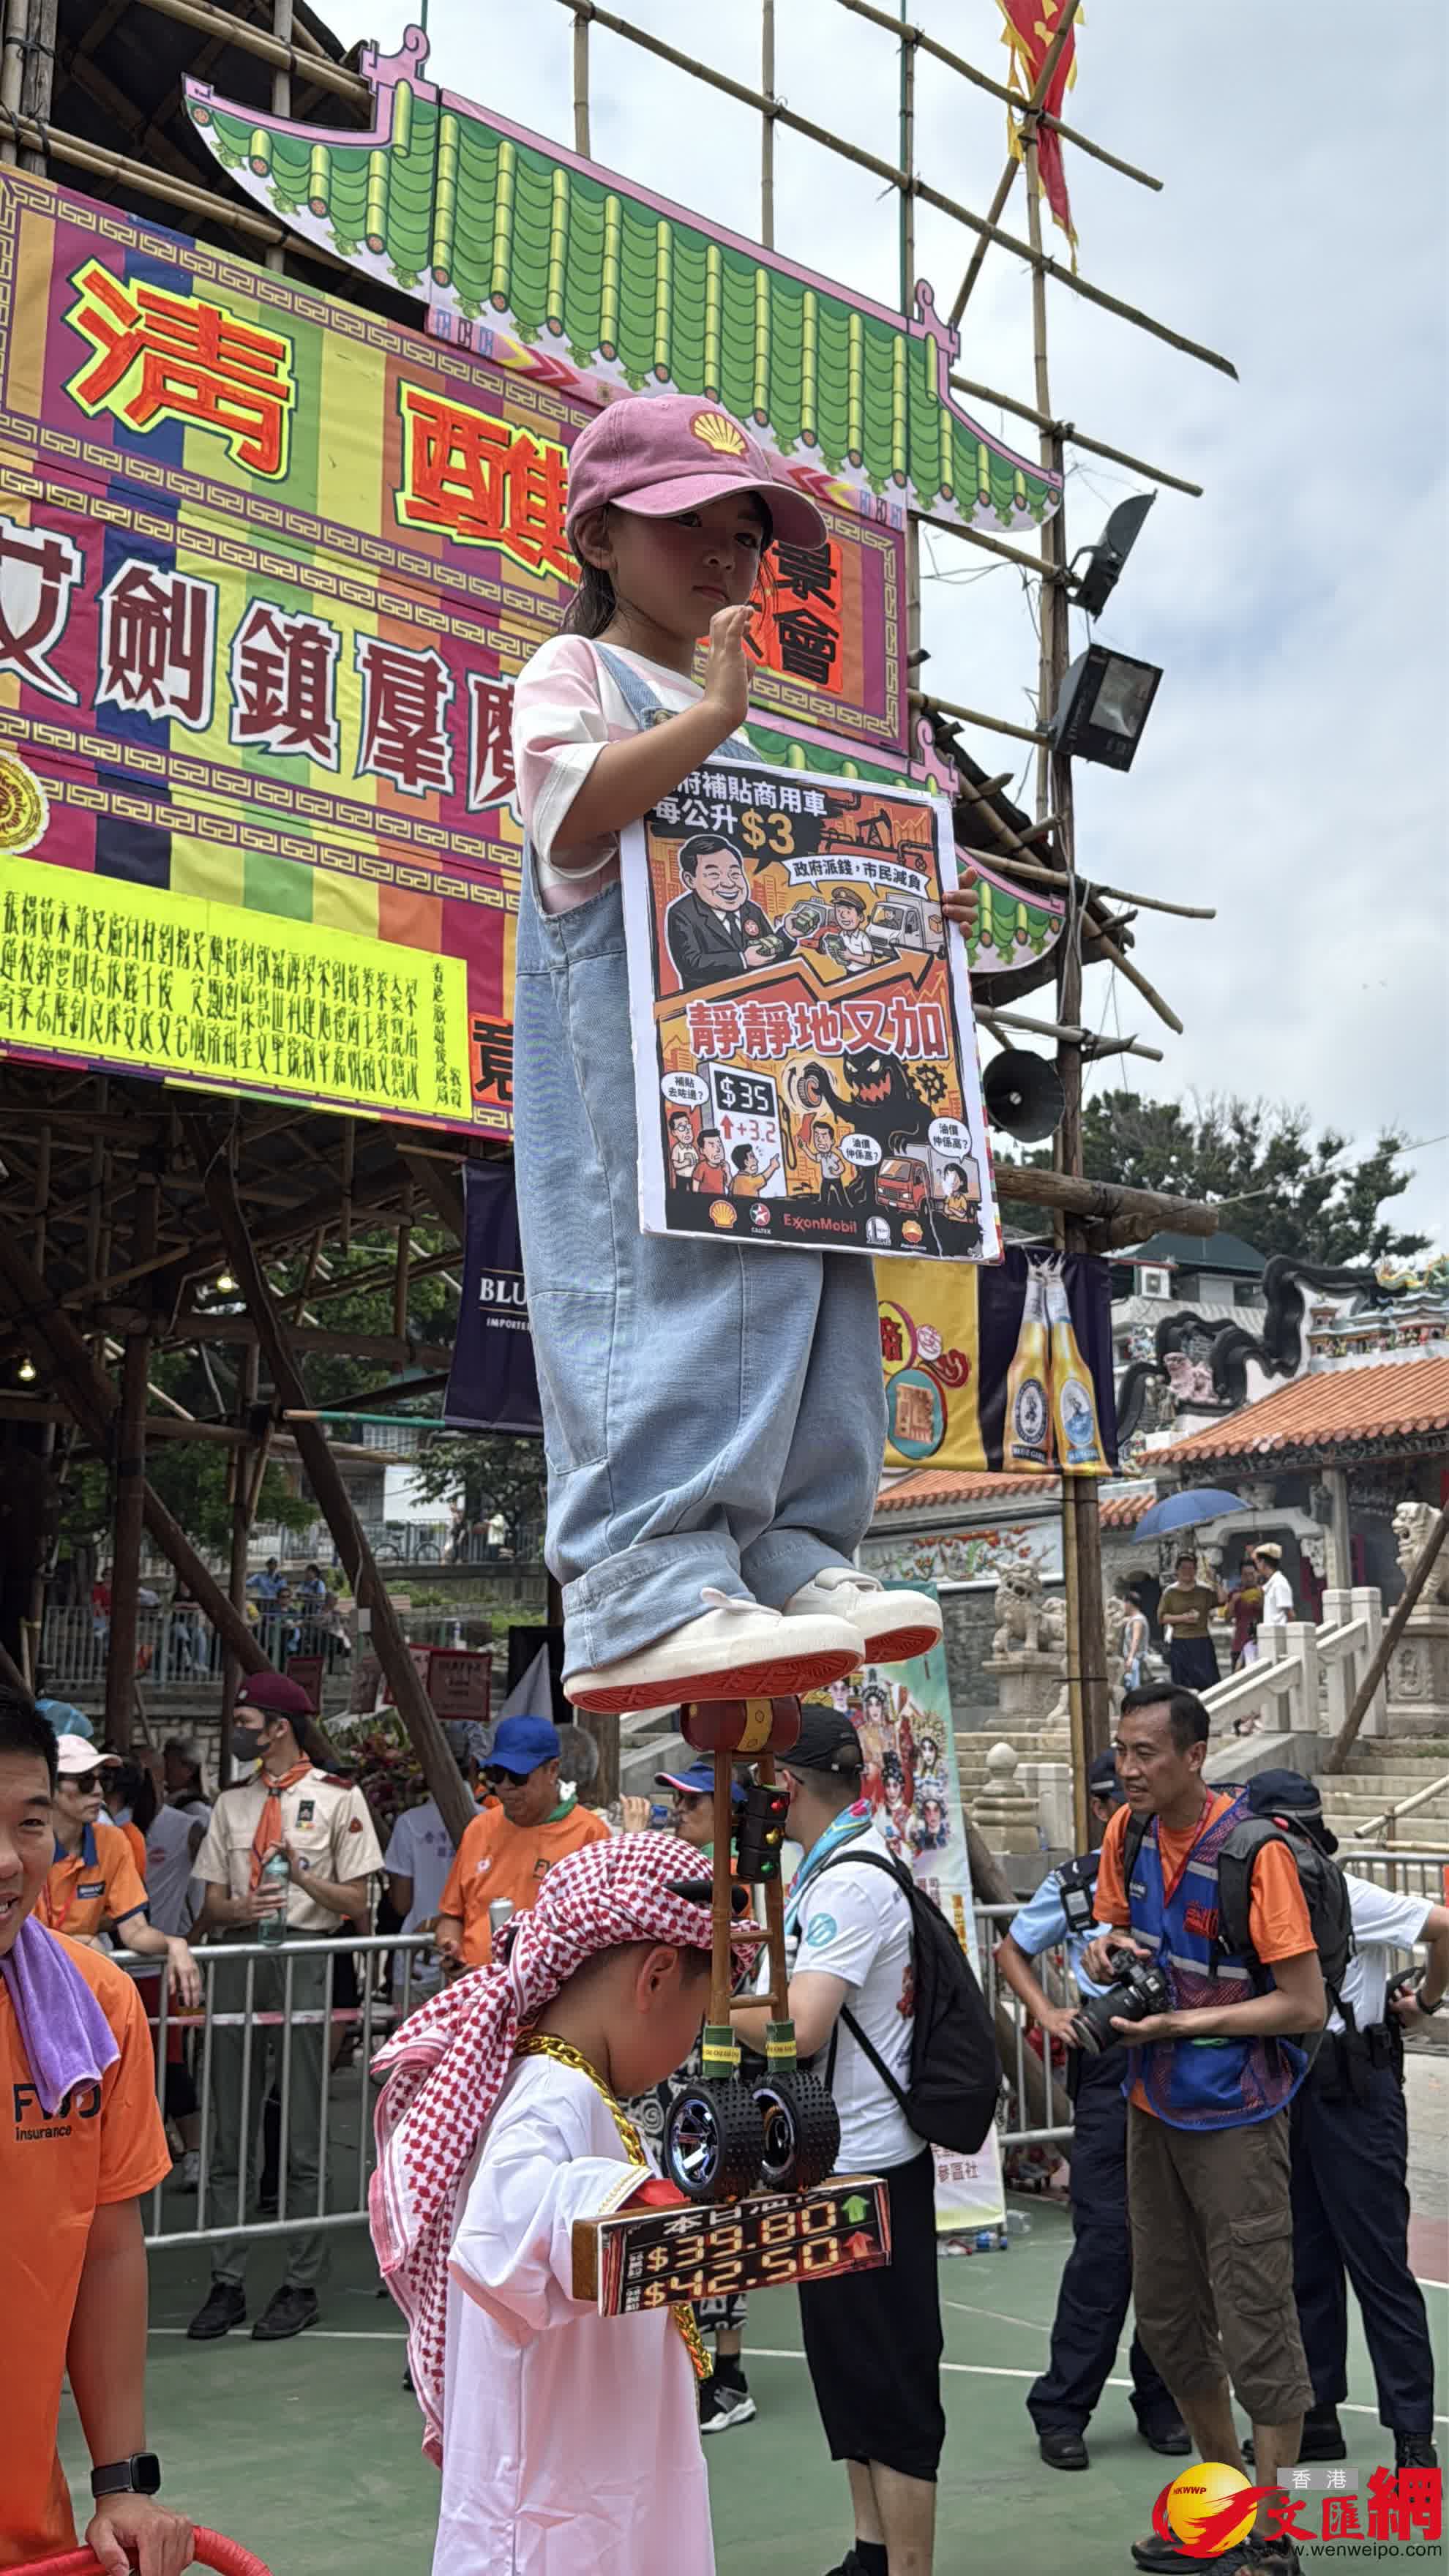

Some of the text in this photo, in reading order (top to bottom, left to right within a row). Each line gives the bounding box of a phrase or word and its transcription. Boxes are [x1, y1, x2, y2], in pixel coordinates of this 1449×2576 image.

[673, 771, 828, 817] 府補貼商用車
[741, 808, 795, 855] $3
[688, 997, 948, 1059] 靜靜地又加
[719, 1076, 769, 1112] $35
[737, 1119, 776, 1144] +3.2
[784, 1213, 857, 1234] ExxonMobil
[646, 2201, 836, 2272] $39.80
[643, 2235, 839, 2307] $42.50
